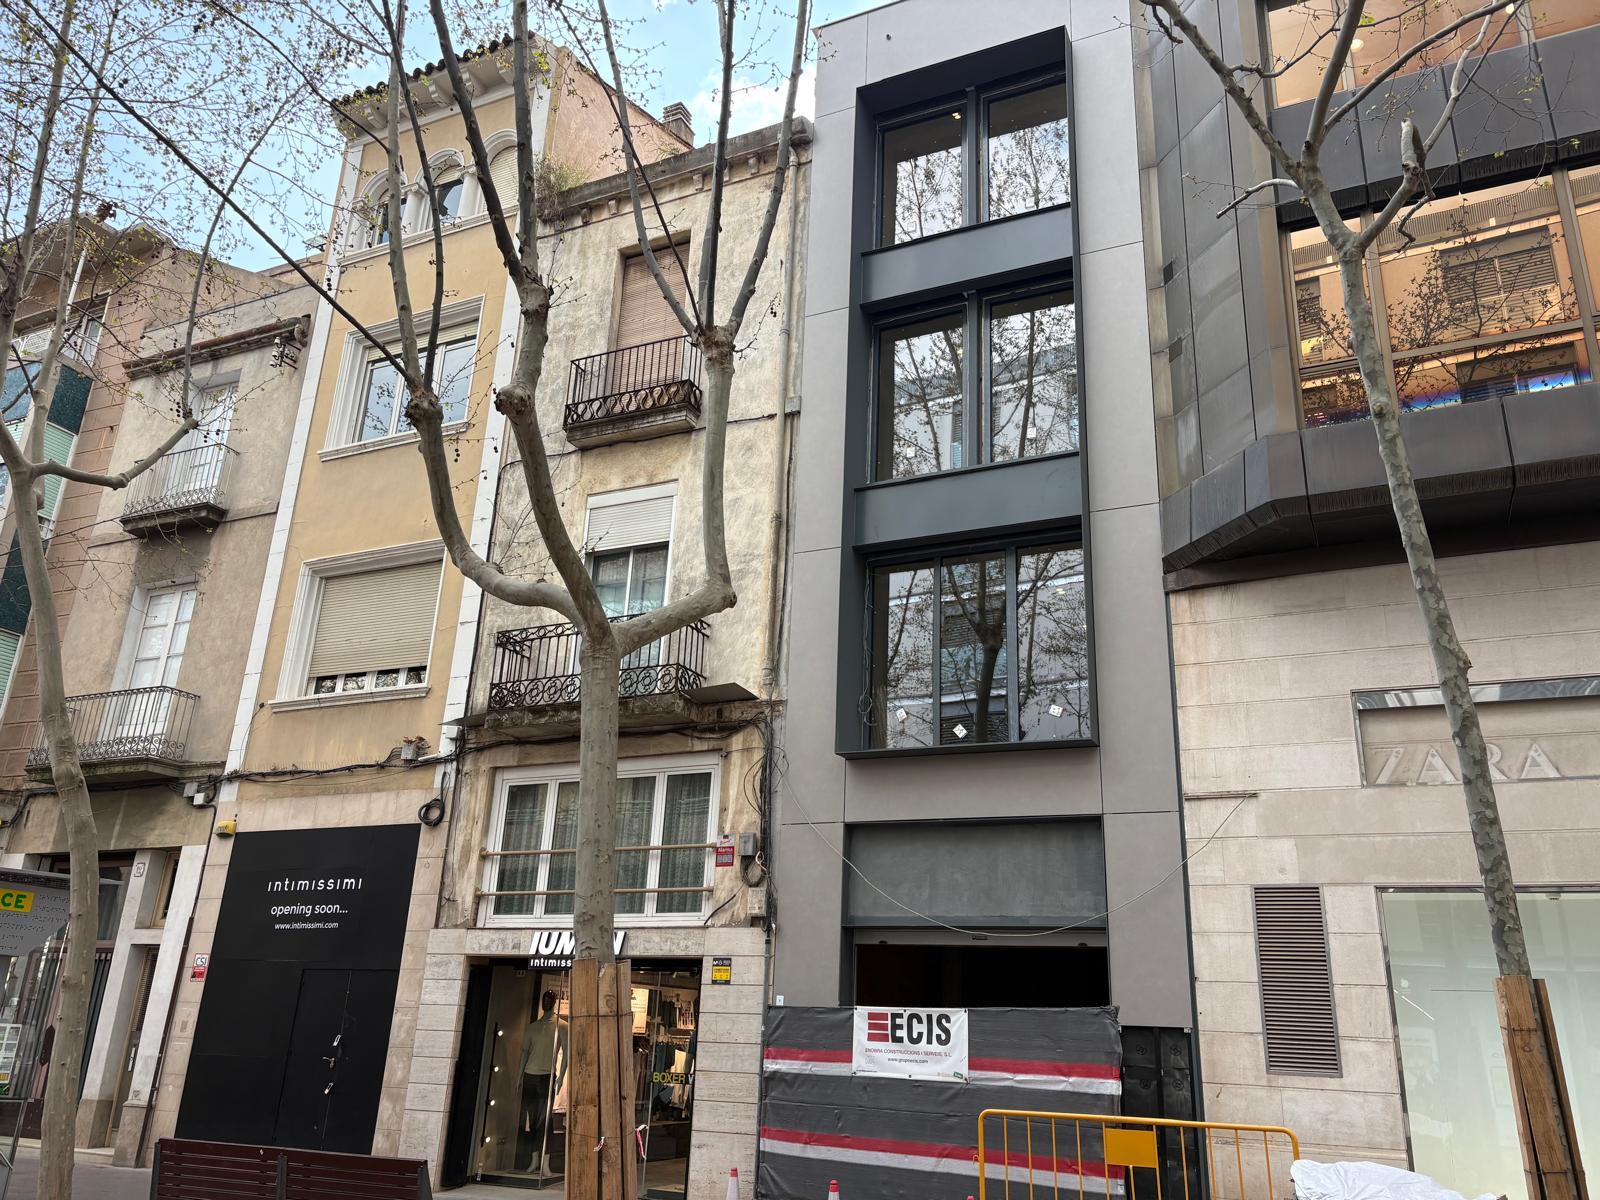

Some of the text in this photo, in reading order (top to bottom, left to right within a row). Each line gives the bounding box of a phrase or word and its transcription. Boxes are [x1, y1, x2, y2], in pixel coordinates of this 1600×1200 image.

[267, 878, 362, 892] intimissimi
[270, 902, 348, 918] opening soon...
[274, 921, 339, 930] www.intimissimi.com
[890, 1012, 952, 1046] ECIS
[652, 1072, 686, 1084] BOXER
